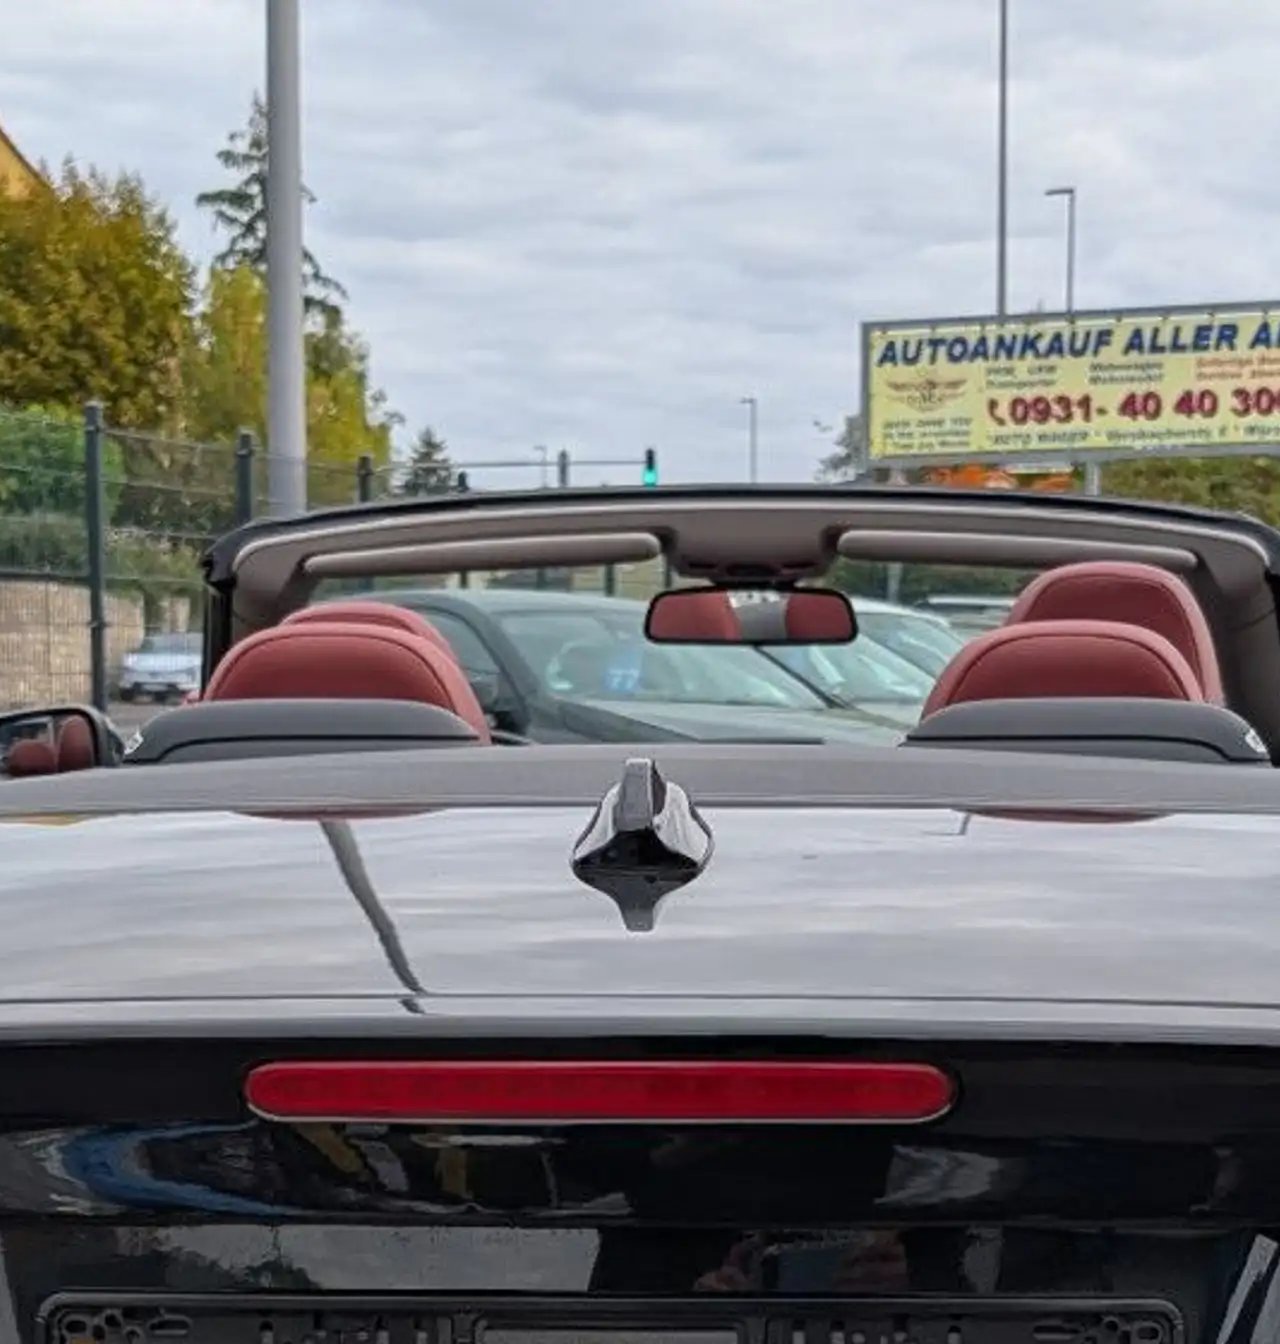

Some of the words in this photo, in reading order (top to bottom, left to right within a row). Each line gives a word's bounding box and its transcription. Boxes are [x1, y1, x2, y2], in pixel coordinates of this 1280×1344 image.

[876, 330, 1112, 367] AUTOANKAUF
[1124, 322, 1238, 357] ALLER
[1117, 390, 1163, 422] 40
[1174, 387, 1219, 419] 40
